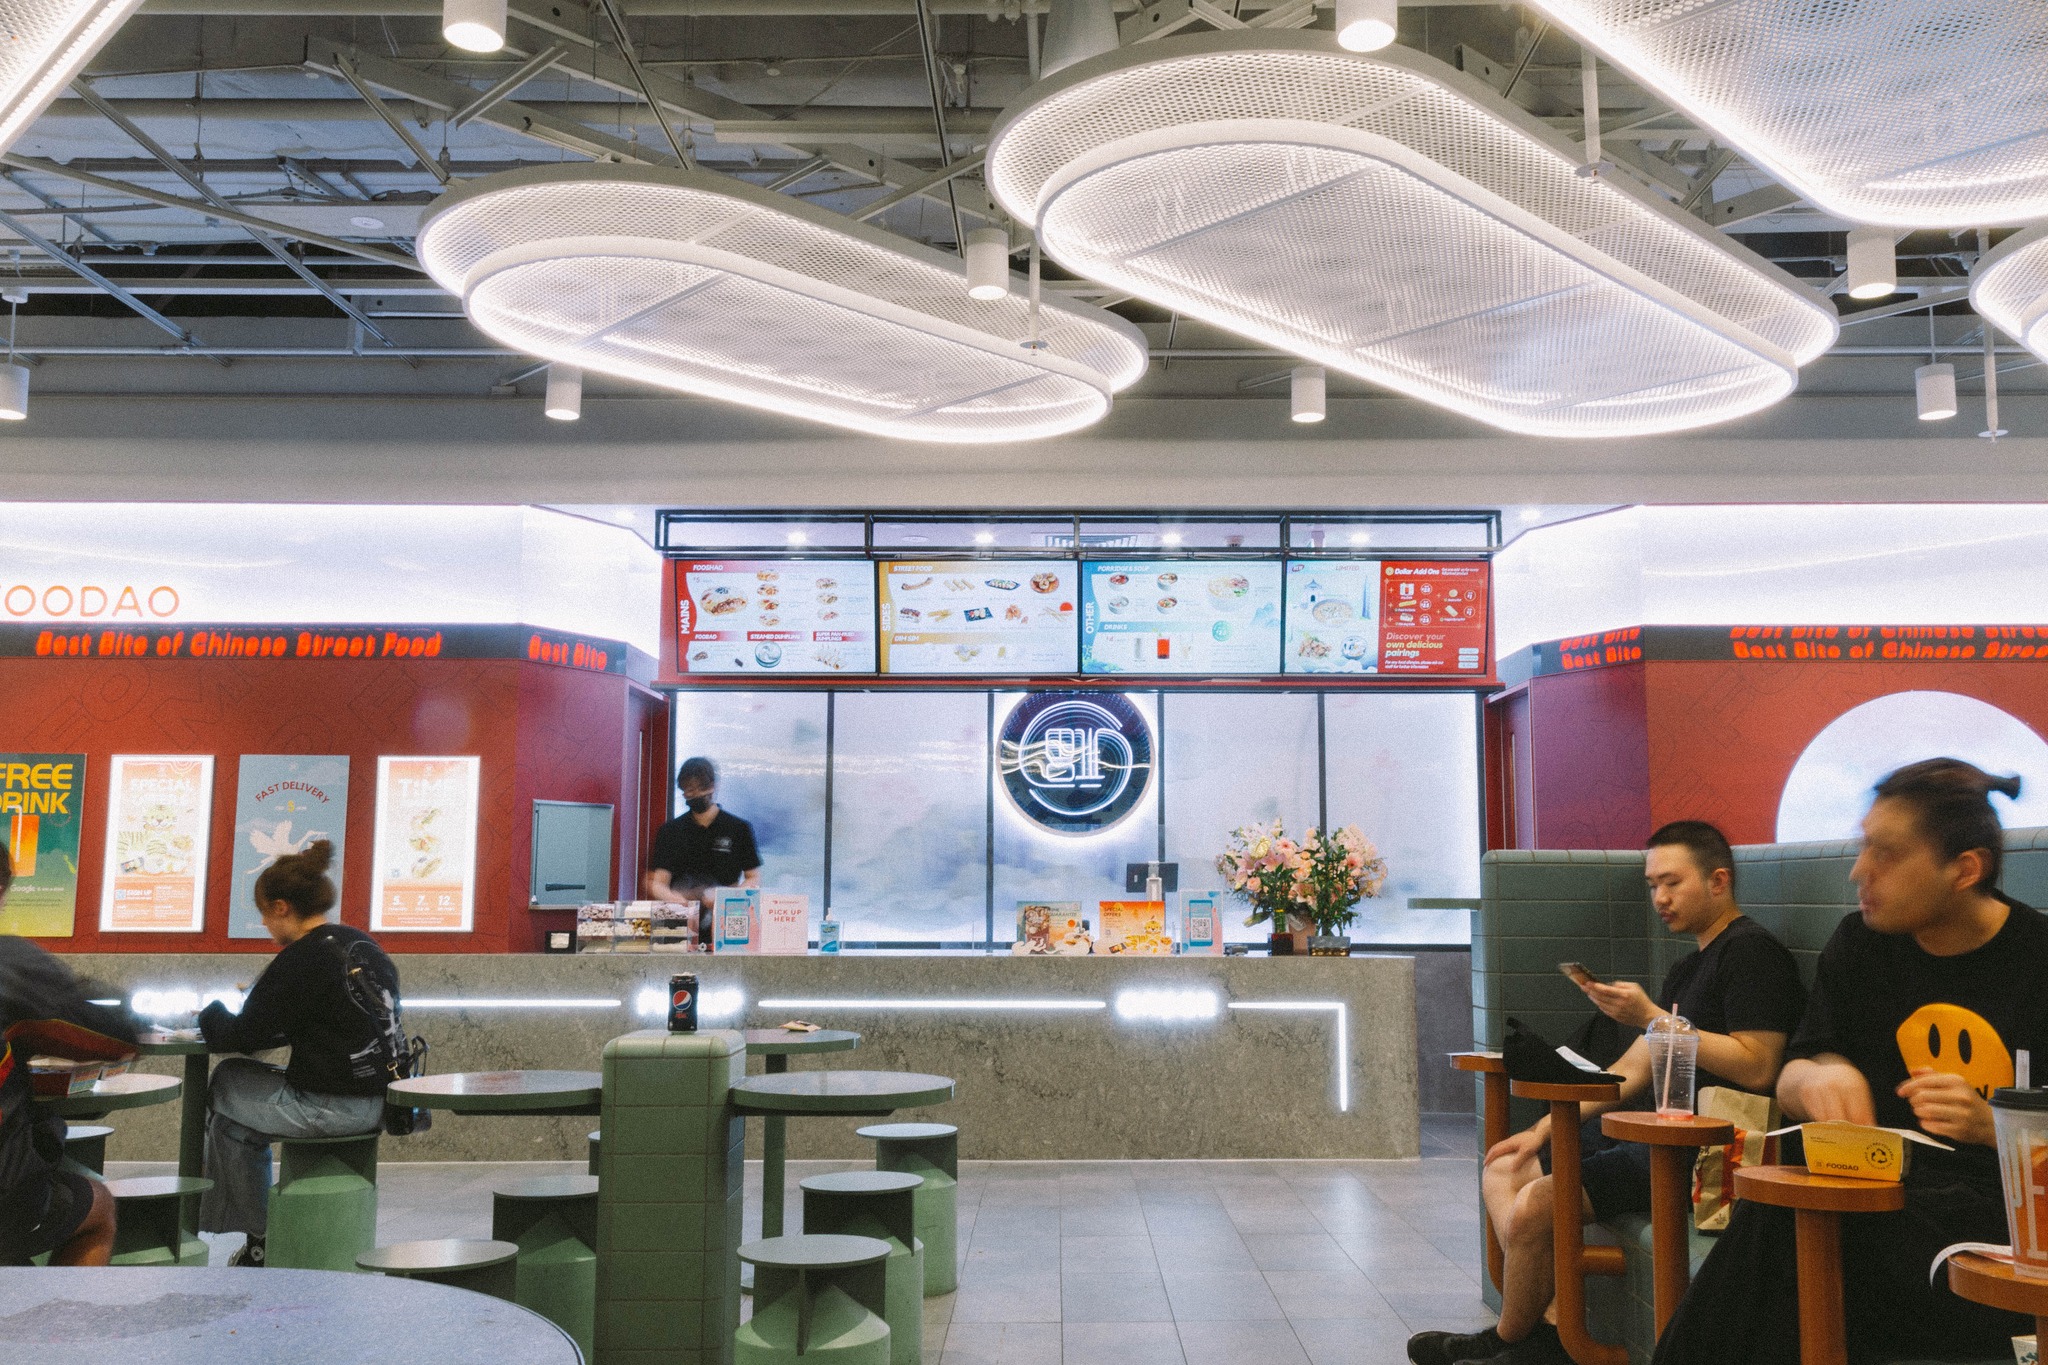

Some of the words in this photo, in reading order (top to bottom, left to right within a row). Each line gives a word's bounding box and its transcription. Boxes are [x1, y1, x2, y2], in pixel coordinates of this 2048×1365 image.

[0, 584, 180, 617] OODAO
[680, 600, 690, 634] MAINS
[882, 603, 891, 632] SIDES
[1085, 602, 1094, 634] OTHER
[1385, 649, 1420, 658] pairings
[0, 791, 70, 814] RINK
[255, 781, 280, 803] FAST
[282, 781, 330, 804] DELIVERY
[1826, 1162, 1860, 1171] FOODAO
